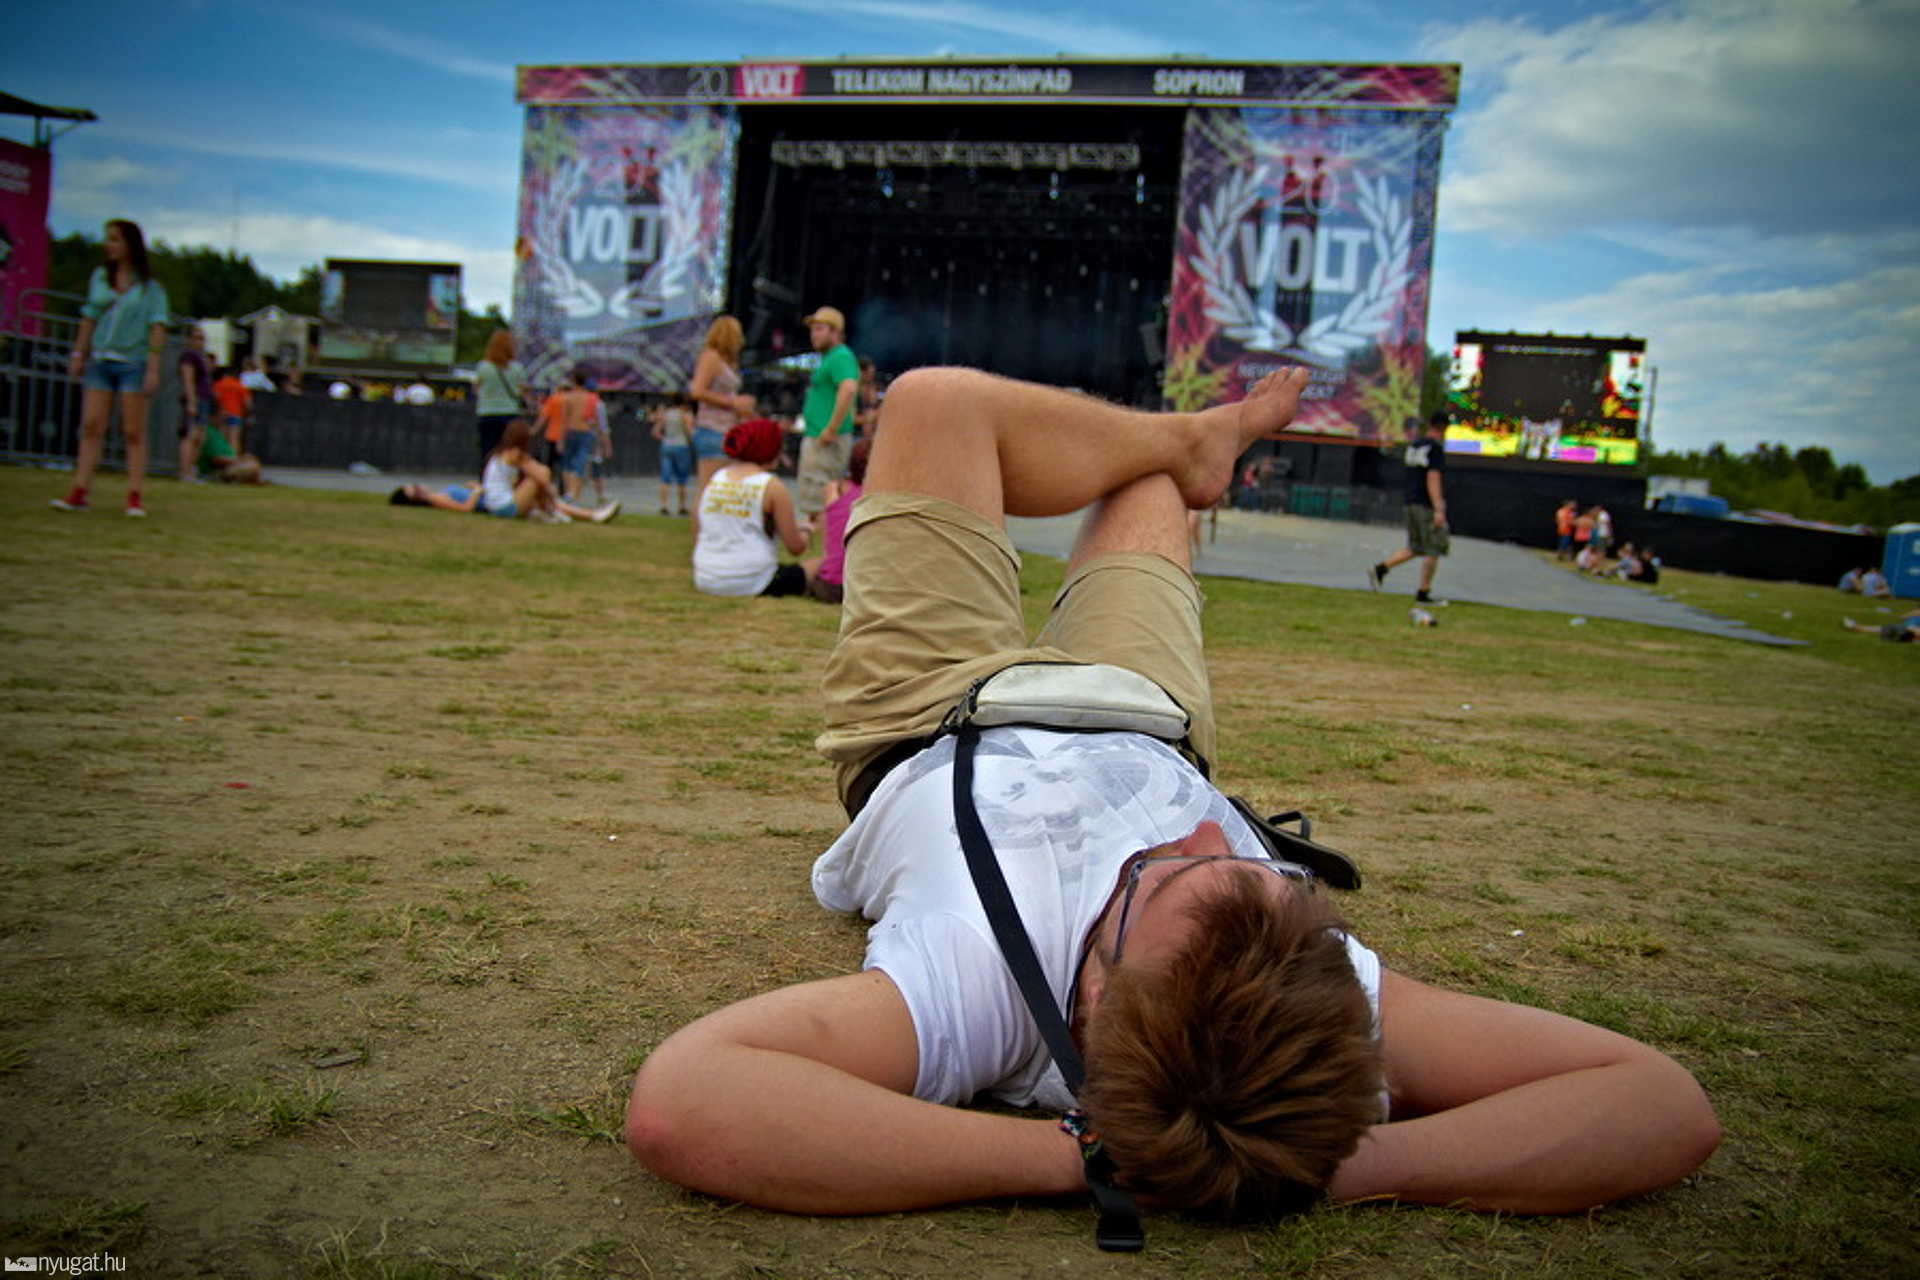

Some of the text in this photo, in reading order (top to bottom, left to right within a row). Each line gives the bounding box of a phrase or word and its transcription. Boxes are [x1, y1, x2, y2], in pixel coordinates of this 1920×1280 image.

[742, 65, 799, 96] VOLT
[832, 68, 924, 93] TELEKOM
[1153, 69, 1245, 95] SOPRON
[1239, 221, 1371, 292] VOLT
